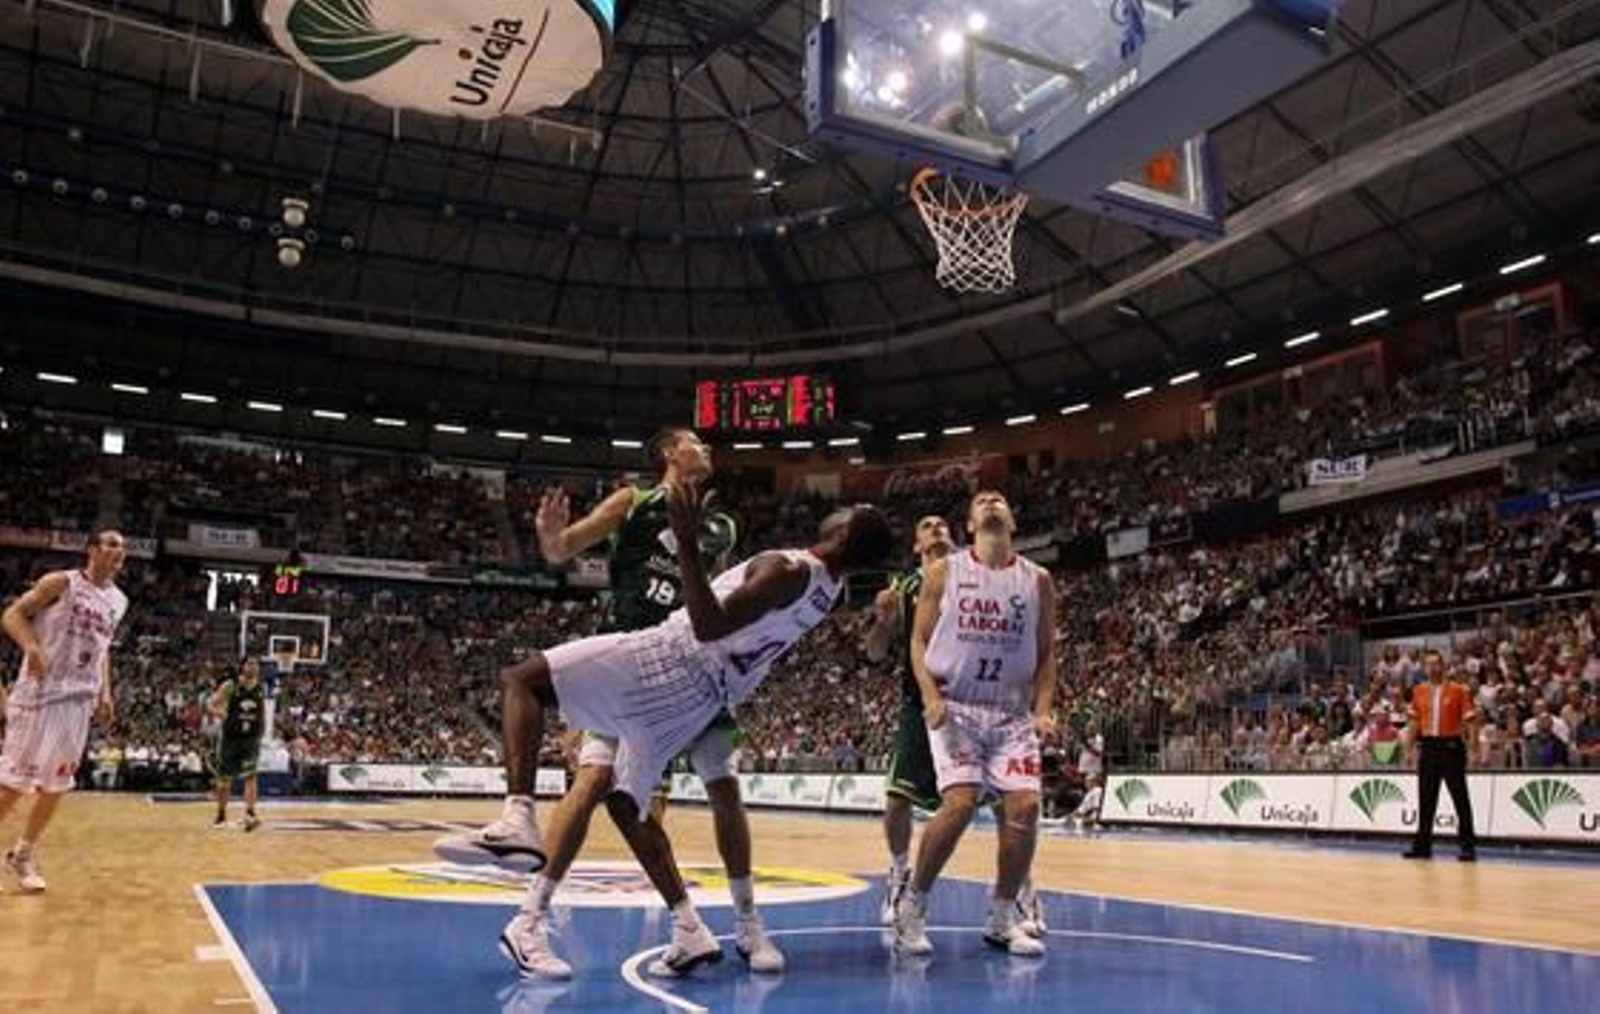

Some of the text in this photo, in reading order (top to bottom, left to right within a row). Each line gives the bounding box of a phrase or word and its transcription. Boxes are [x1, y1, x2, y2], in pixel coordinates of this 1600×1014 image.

[450, 19, 526, 106] Unicaja
[976, 658, 1003, 681] 12
[1146, 800, 1195, 821] Unicaja
[1260, 803, 1320, 825] Unicaja
